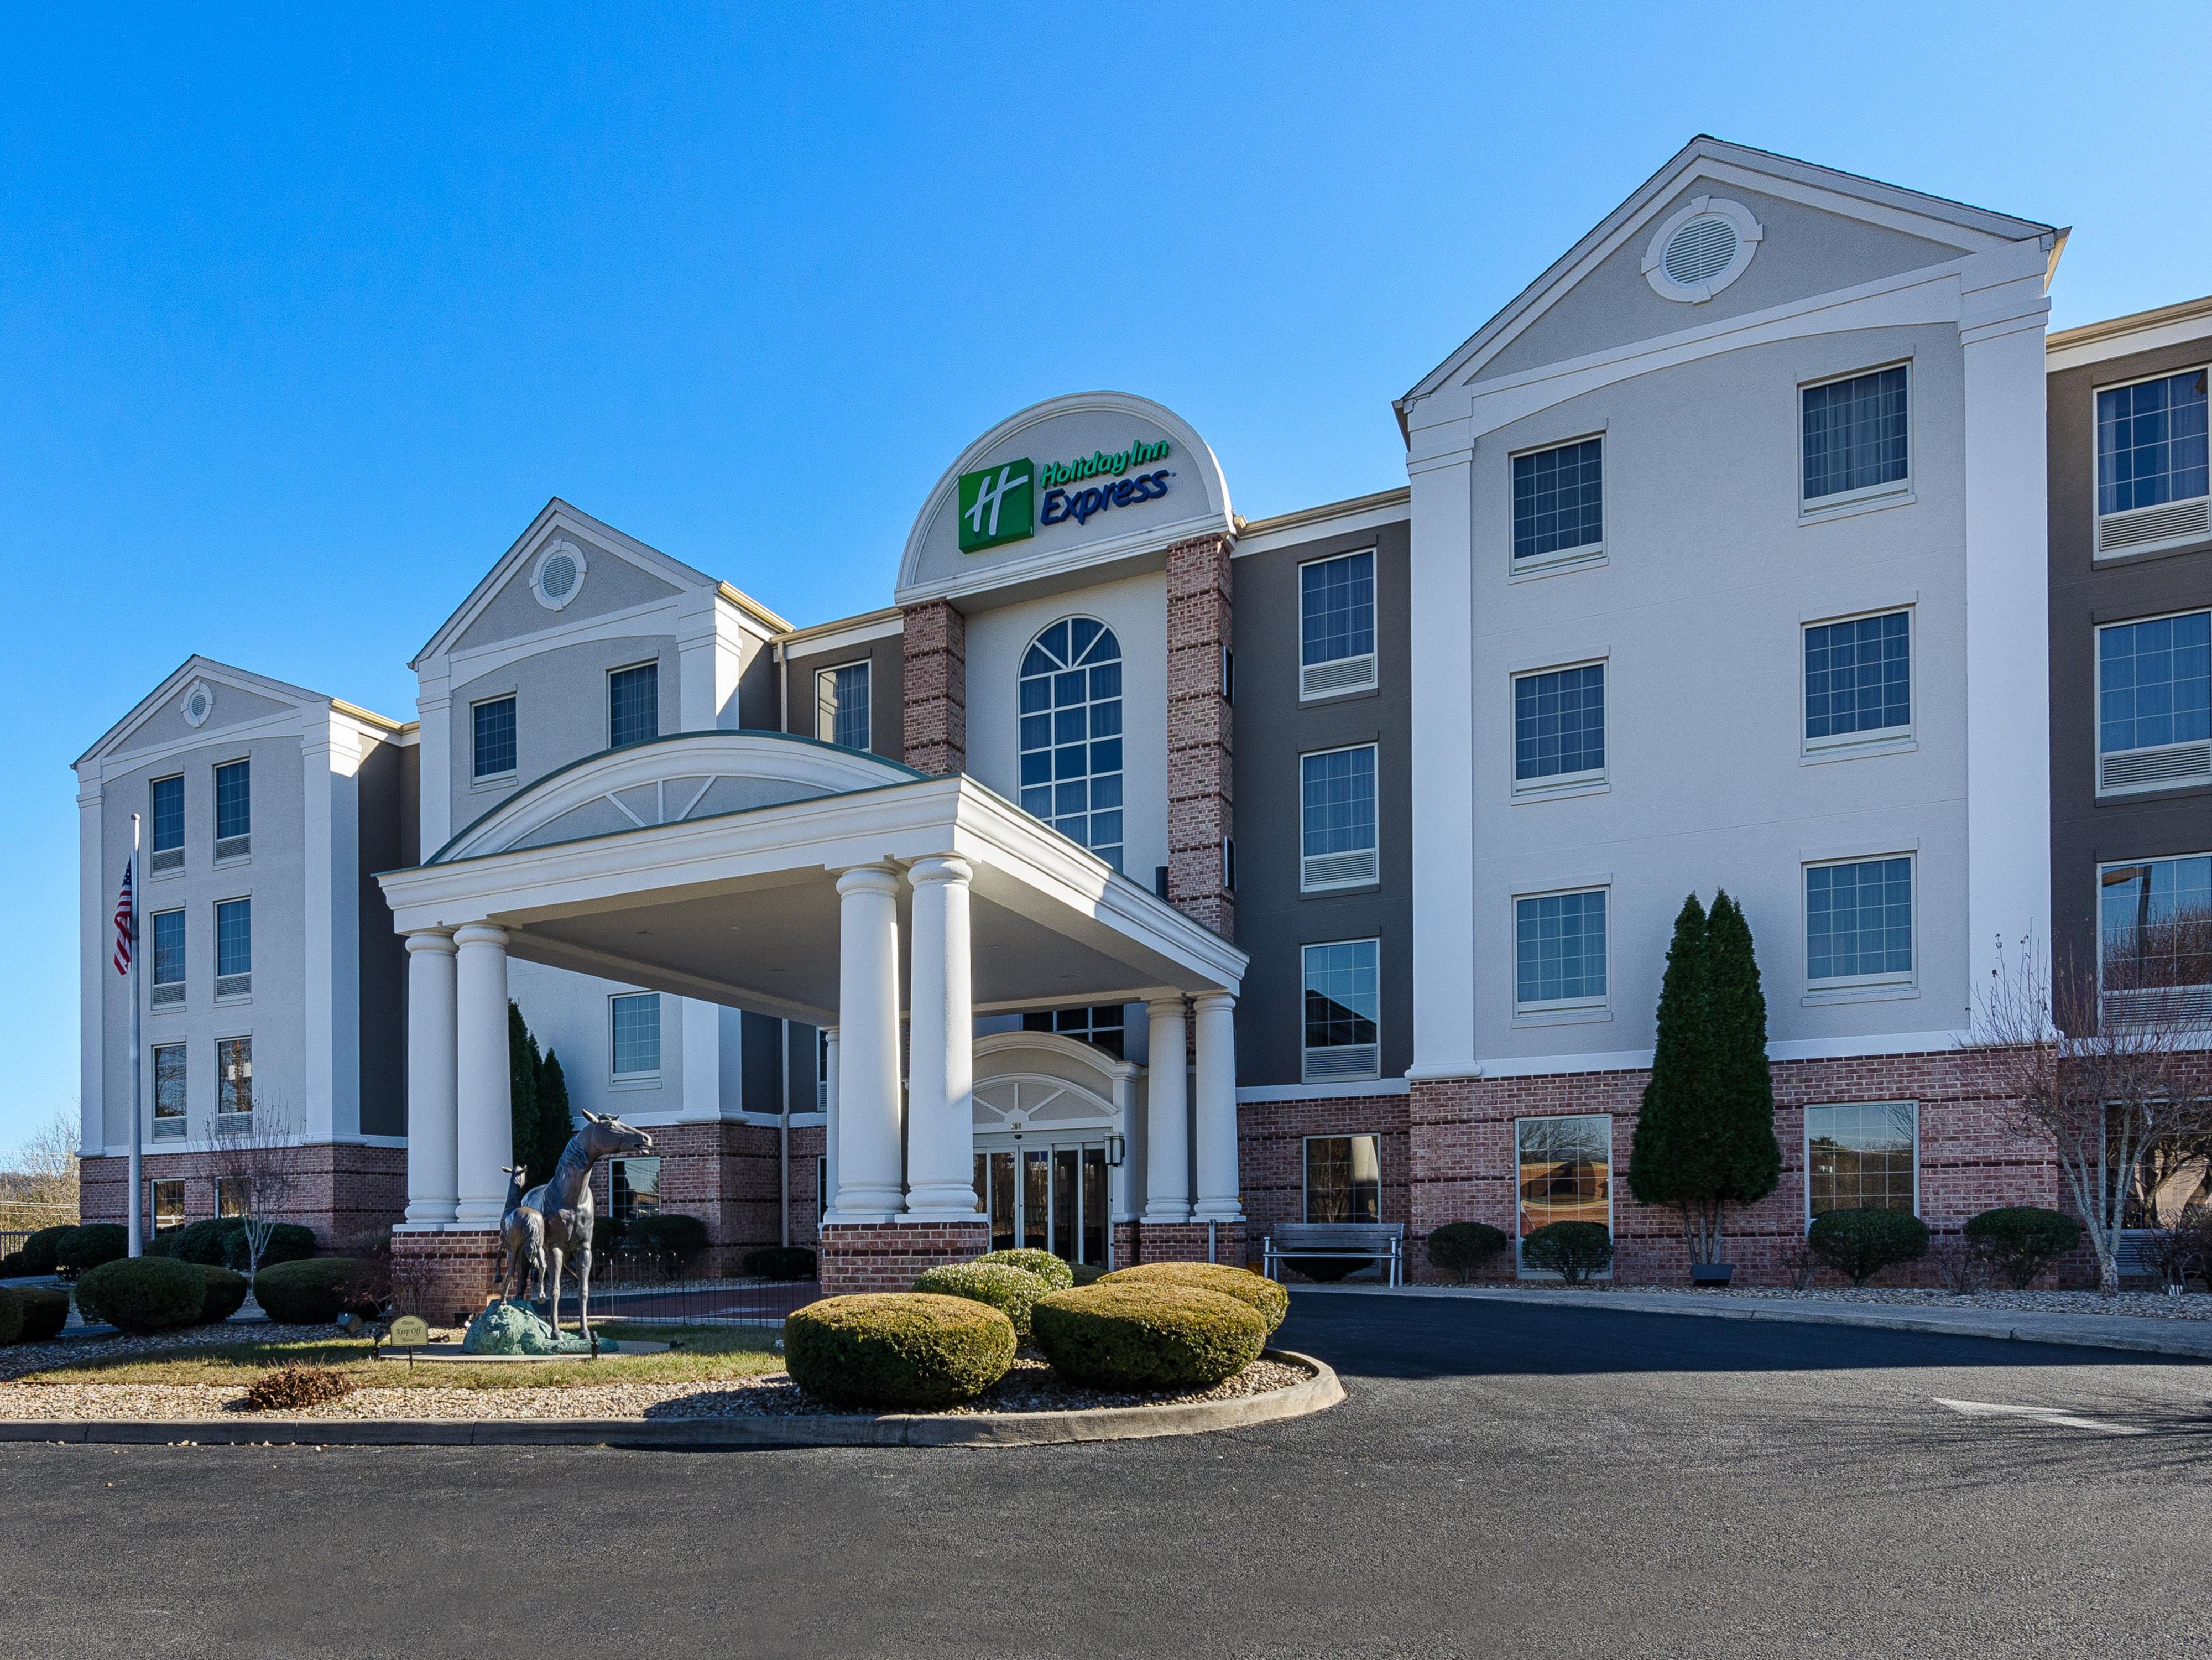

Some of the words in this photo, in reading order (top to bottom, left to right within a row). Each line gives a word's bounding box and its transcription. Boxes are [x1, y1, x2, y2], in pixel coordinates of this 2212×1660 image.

[1040, 451, 1129, 490] Holiday
[1131, 439, 1170, 467] Inn
[1040, 470, 1169, 525] Express
[411, 1326, 422, 1336] Off
